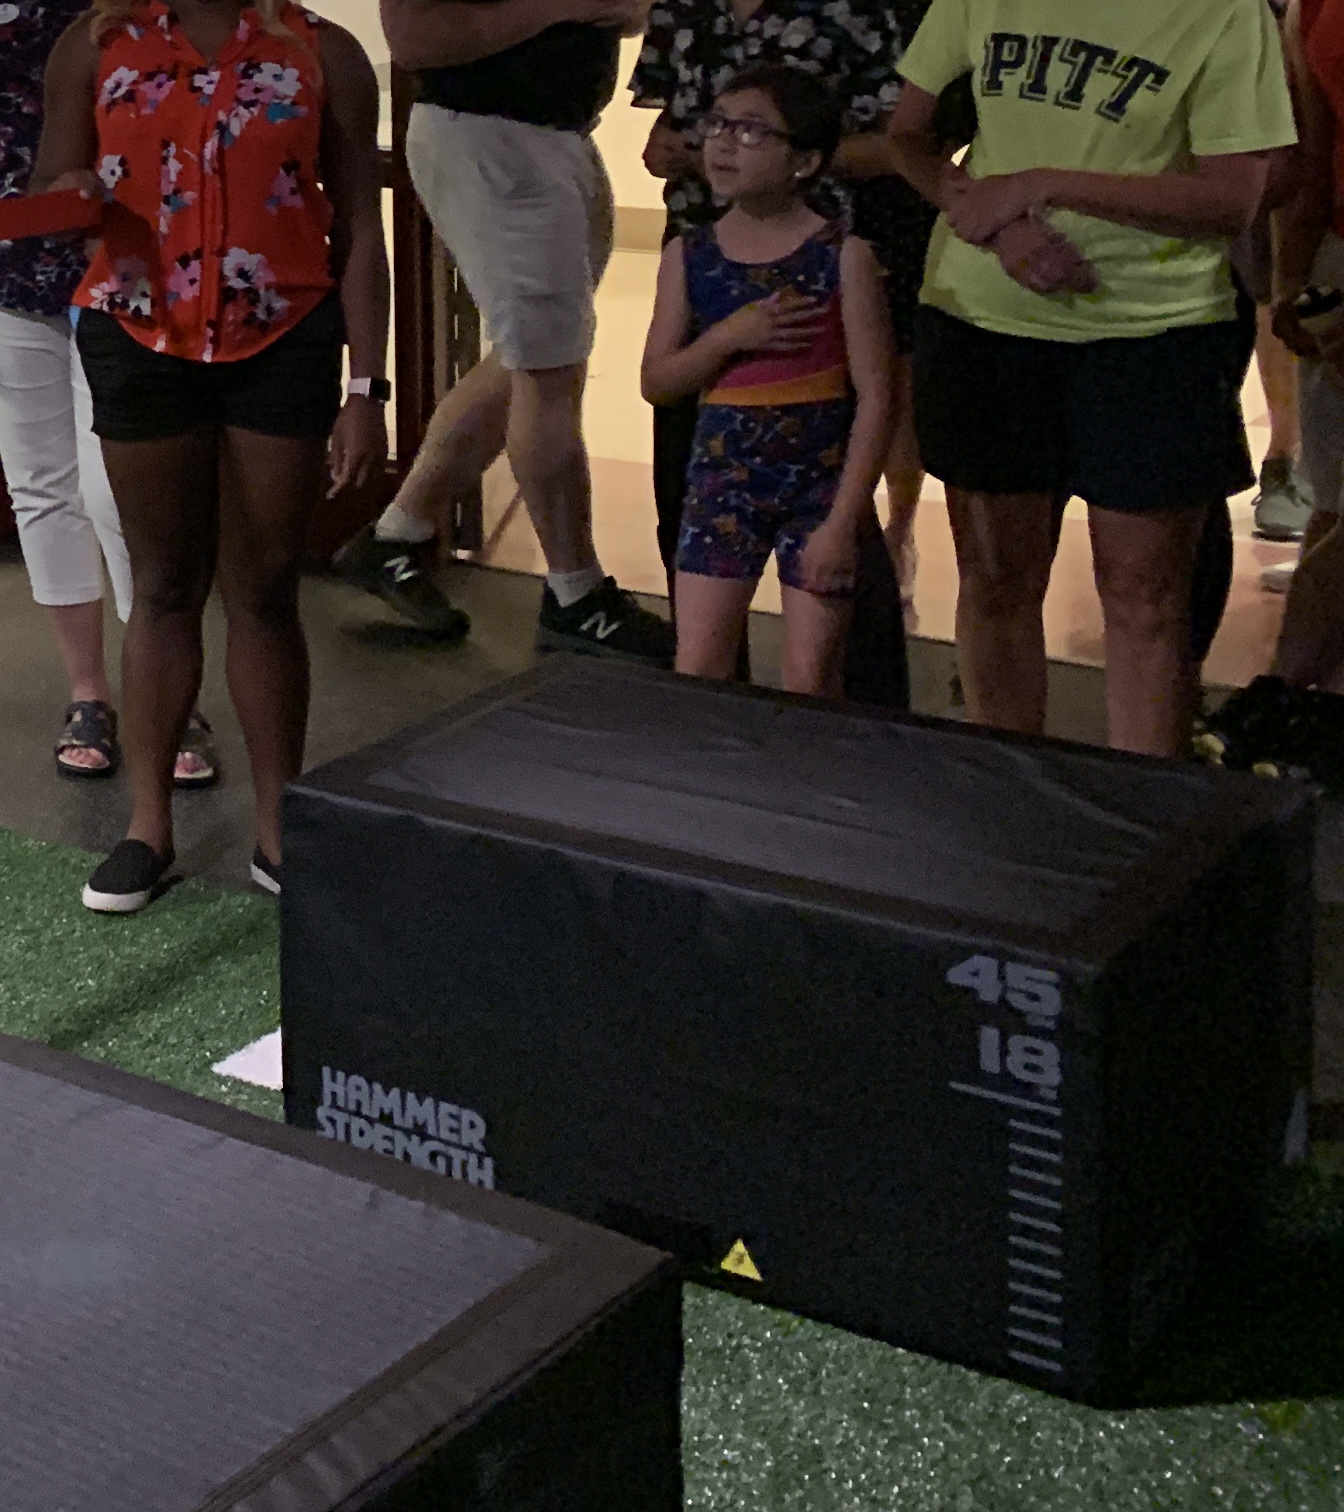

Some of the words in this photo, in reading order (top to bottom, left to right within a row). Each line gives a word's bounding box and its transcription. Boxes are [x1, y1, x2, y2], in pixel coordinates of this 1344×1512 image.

[981, 32, 1172, 124] PITT
[945, 954, 1063, 1017] 45
[977, 1024, 1063, 1088] 18
[316, 1104, 496, 1191] STRENGTH
[320, 1064, 488, 1153] HAMMER
